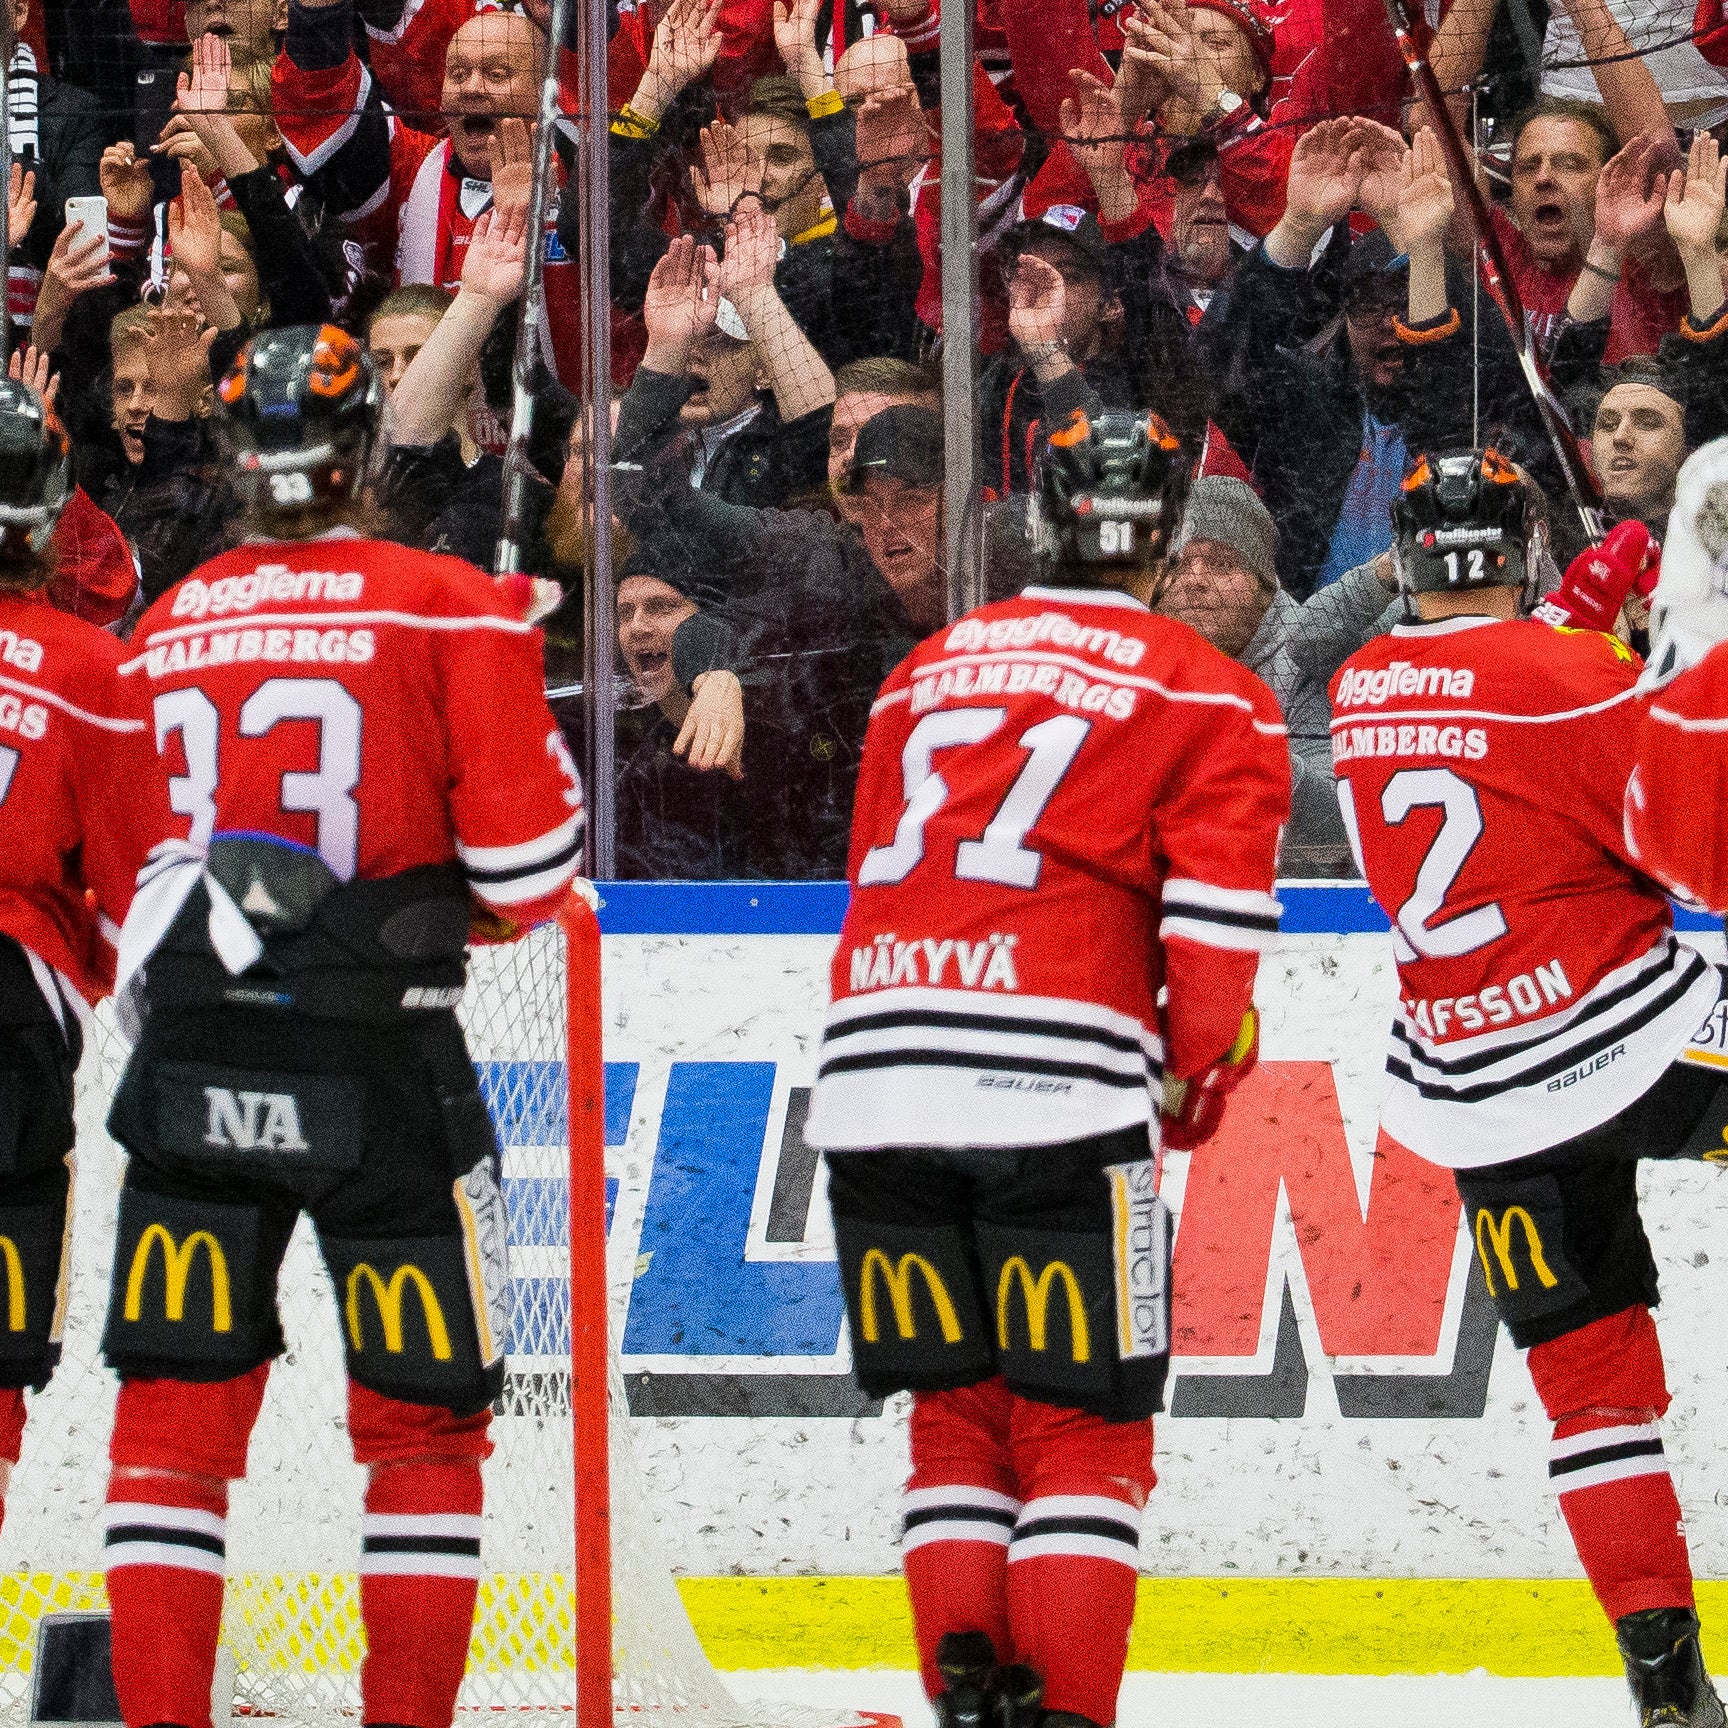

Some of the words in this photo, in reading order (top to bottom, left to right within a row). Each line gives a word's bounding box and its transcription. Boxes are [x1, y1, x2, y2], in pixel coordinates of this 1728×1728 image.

[1100, 521, 1135, 553] 51
[172, 564, 364, 619] ByggTema
[1445, 550, 1484, 582] 12
[944, 613, 1147, 668] ByggTema
[909, 663, 1138, 722] MALMBERGS
[850, 932, 1019, 993] NÄKYVÄ
[1546, 1042, 1628, 1094] BAUER
[203, 1086, 311, 1152] NA
